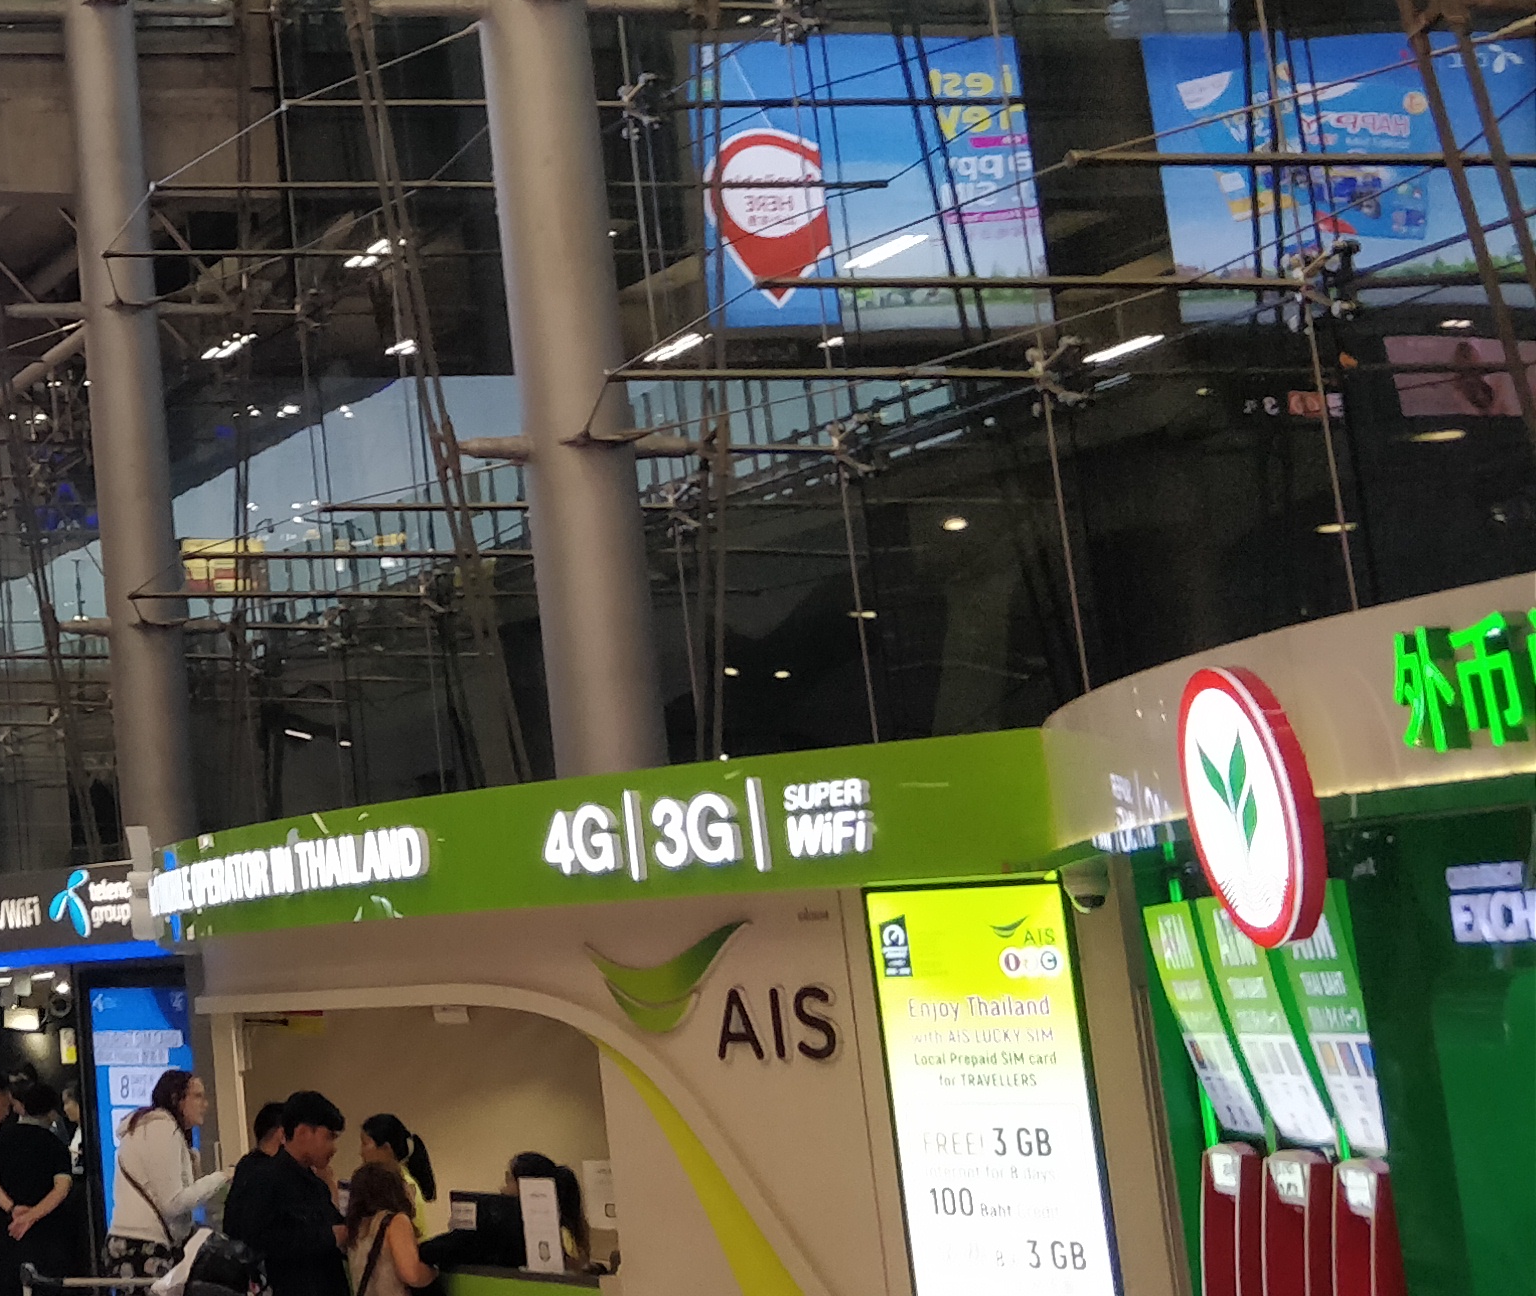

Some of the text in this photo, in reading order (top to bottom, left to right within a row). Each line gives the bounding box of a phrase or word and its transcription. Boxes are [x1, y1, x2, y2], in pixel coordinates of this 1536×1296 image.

[1393, 607, 1536, 753] 外币
[784, 778, 862, 811] SUPER
[543, 793, 866, 875] 4G 3G WiFi
[191, 849, 270, 907] OPERATOR
[270, 844, 294, 895] IN
[294, 826, 422, 891] THAILAND
[1024, 929, 1056, 945] AIS
[718, 985, 837, 1062] AIS
[908, 995, 1050, 1022] Enjoy Thailand
[975, 1028, 1021, 1044] LUCKY
[1027, 1026, 1055, 1043] SIM
[914, 1050, 1058, 1068] Local Prepaid SIM card
[120, 1074, 130, 1099] 8
[939, 1073, 1039, 1087] for TRAVELLERS
[923, 1127, 1053, 1157] FREE! 3 GB
[929, 1187, 975, 1217] 100
[980, 1203, 1012, 1218] Baht
[1026, 1239, 1042, 1270] 3
[1050, 1240, 1088, 1271] GB
